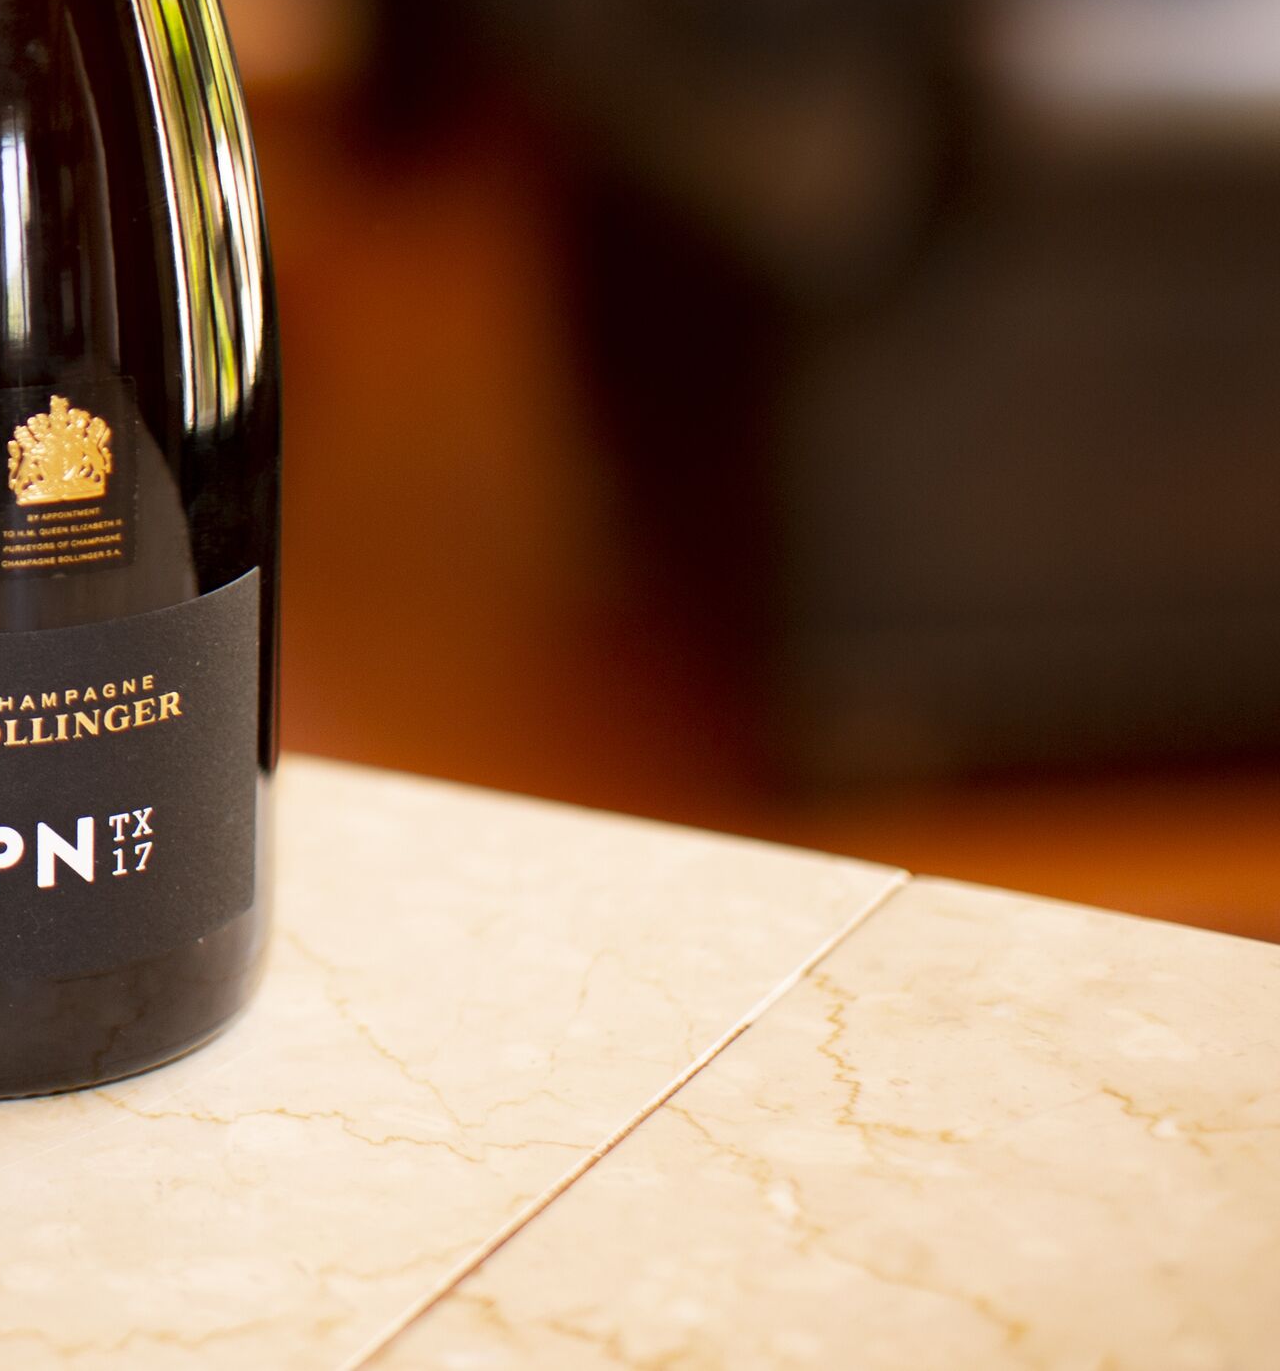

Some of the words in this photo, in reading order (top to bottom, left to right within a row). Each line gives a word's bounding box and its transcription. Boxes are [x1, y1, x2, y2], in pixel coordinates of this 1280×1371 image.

[26, 514, 39, 523] BY
[41, 507, 100, 520] APPOINTMENT
[3, 530, 15, 538] TO
[39, 526, 68, 536] QUEEN
[70, 520, 114, 532] ELIZABETH
[3, 542, 55, 553] PURVEYORS
[56, 540, 69, 549] OF
[70, 533, 121, 548] CHAMPAGNE
[1, 556, 56, 568] CHAMPAGNE
[57, 550, 104, 563] BOLLINGER
[108, 807, 153, 842] TX
[111, 841, 153, 875] 17
